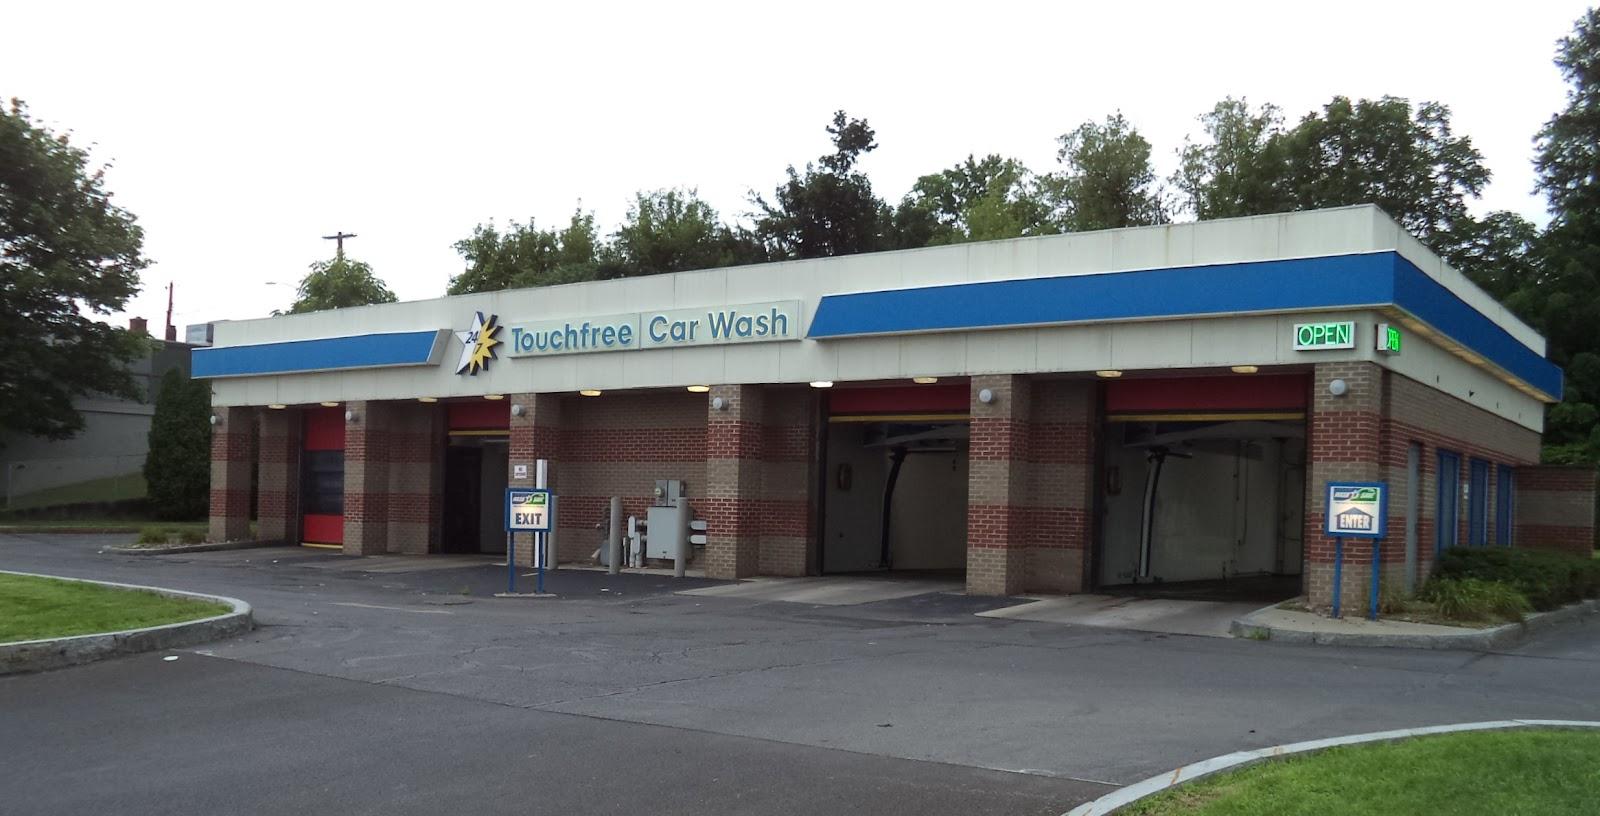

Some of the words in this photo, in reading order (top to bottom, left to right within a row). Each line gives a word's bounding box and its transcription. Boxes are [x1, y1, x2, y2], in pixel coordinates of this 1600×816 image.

[465, 330, 479, 344] 24
[511, 322, 632, 353] Touchfree
[649, 316, 699, 342] Car
[708, 308, 787, 339] Wash
[1299, 324, 1350, 345] OPEN
[475, 342, 484, 354] 7
[515, 512, 542, 525] EXIT
[1340, 514, 1370, 529] ENTER
